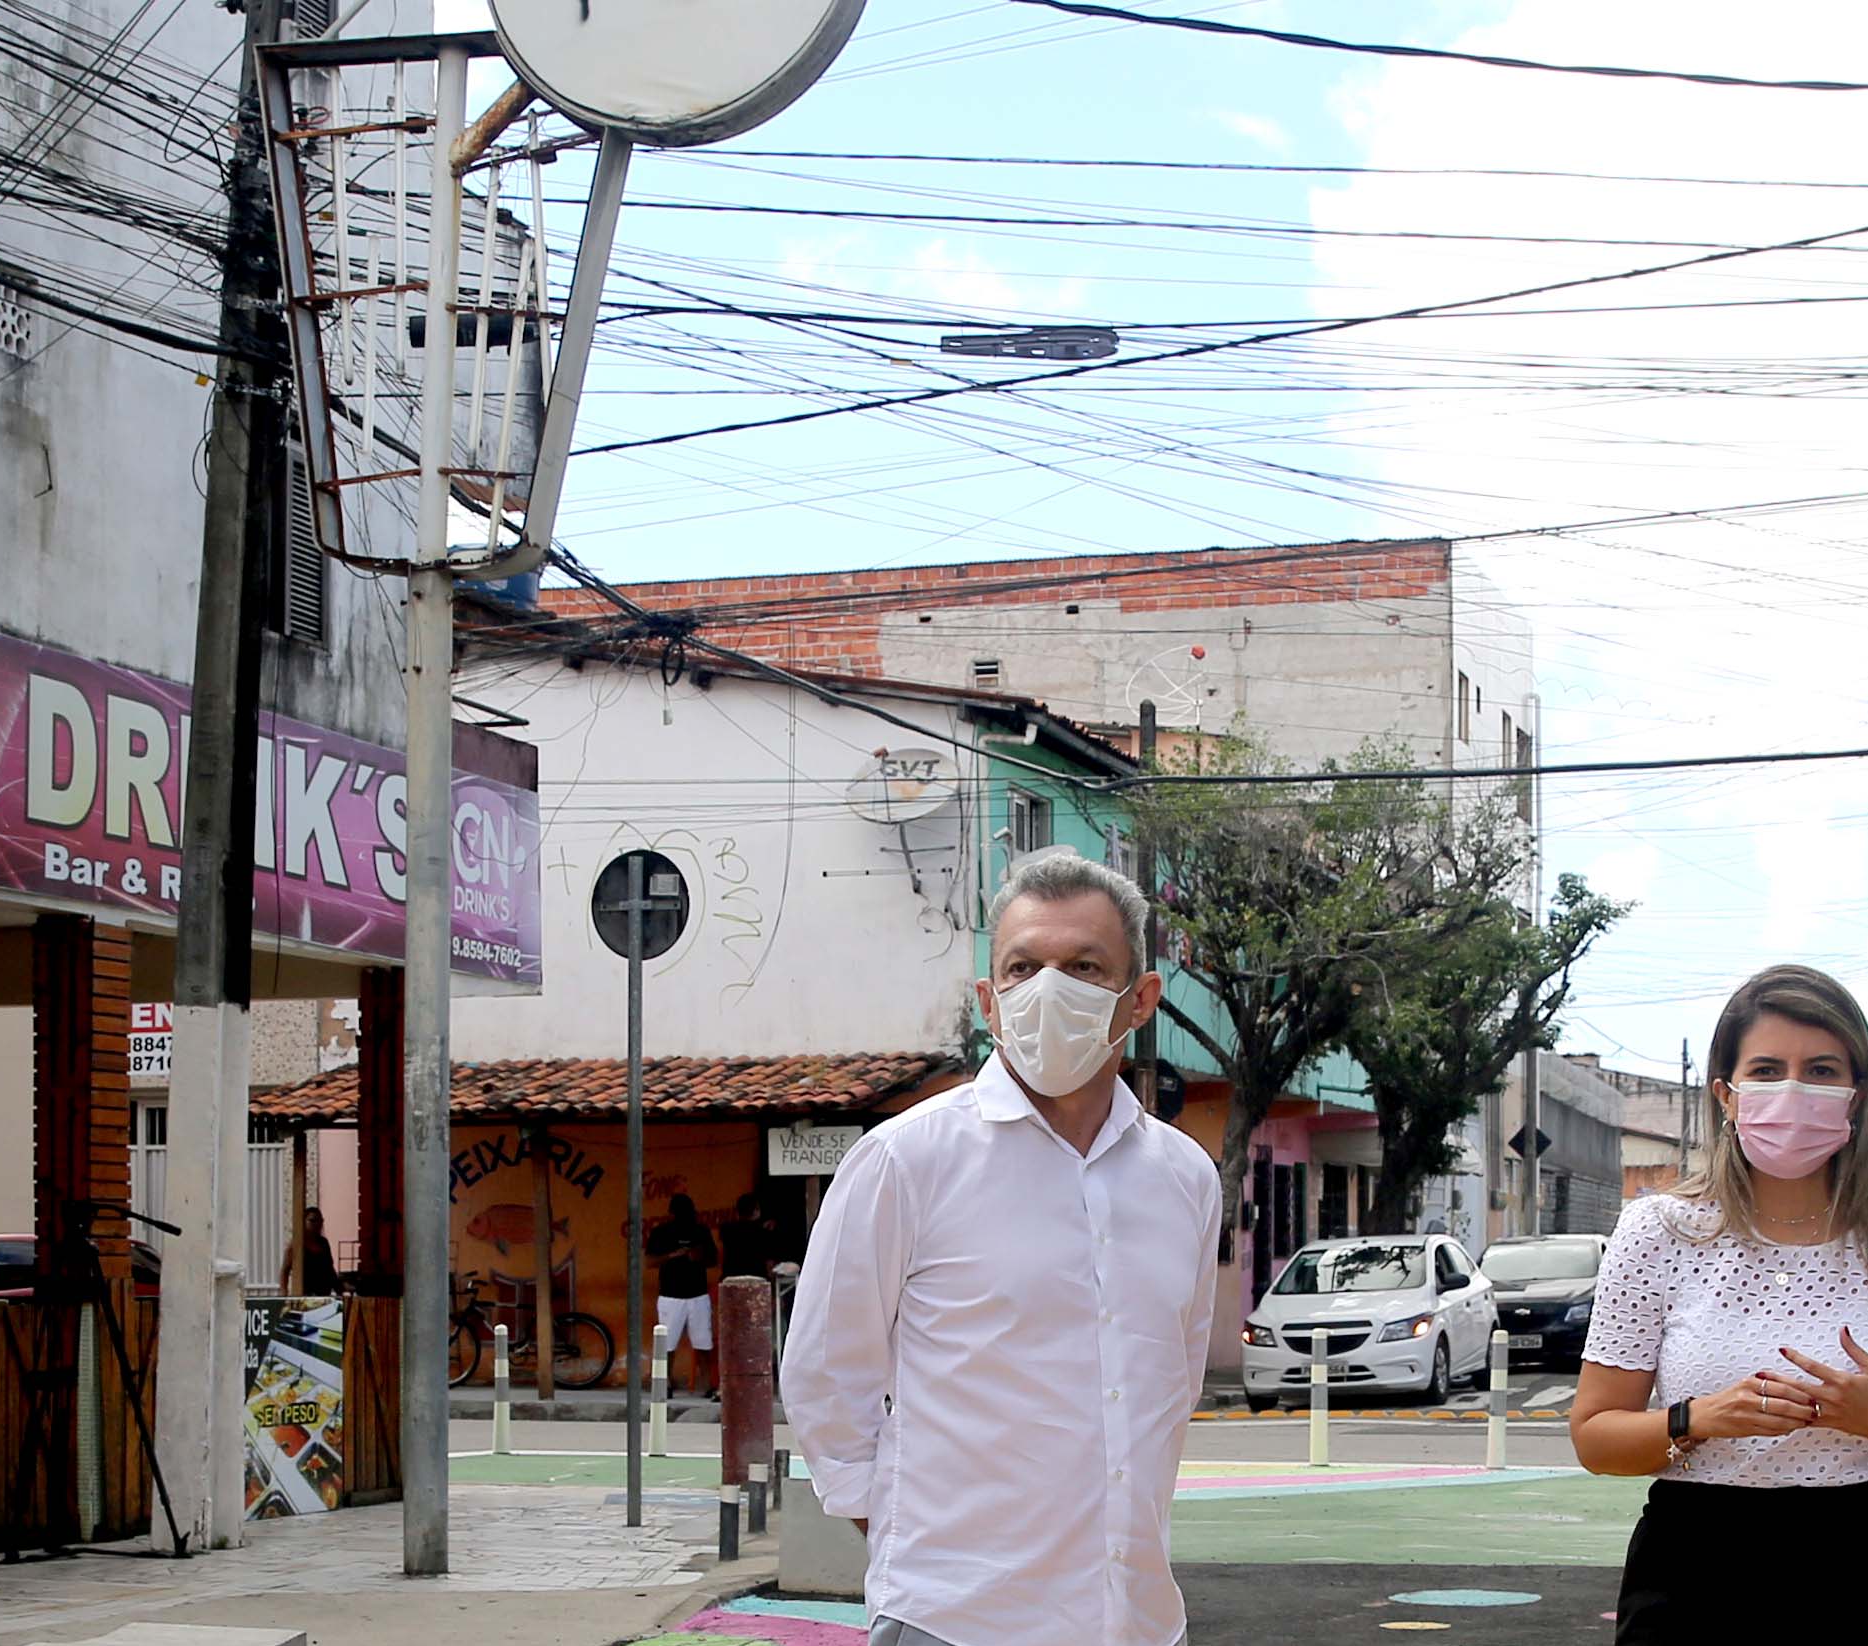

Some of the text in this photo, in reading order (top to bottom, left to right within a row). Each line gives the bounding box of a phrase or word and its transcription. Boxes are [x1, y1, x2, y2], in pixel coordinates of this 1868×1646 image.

[452, 801, 511, 889] CN
[44, 842, 107, 889] Bar
[119, 857, 148, 896] &
[454, 885, 510, 923] DRINK'S
[451, 936, 522, 968] 9.8594-7602
